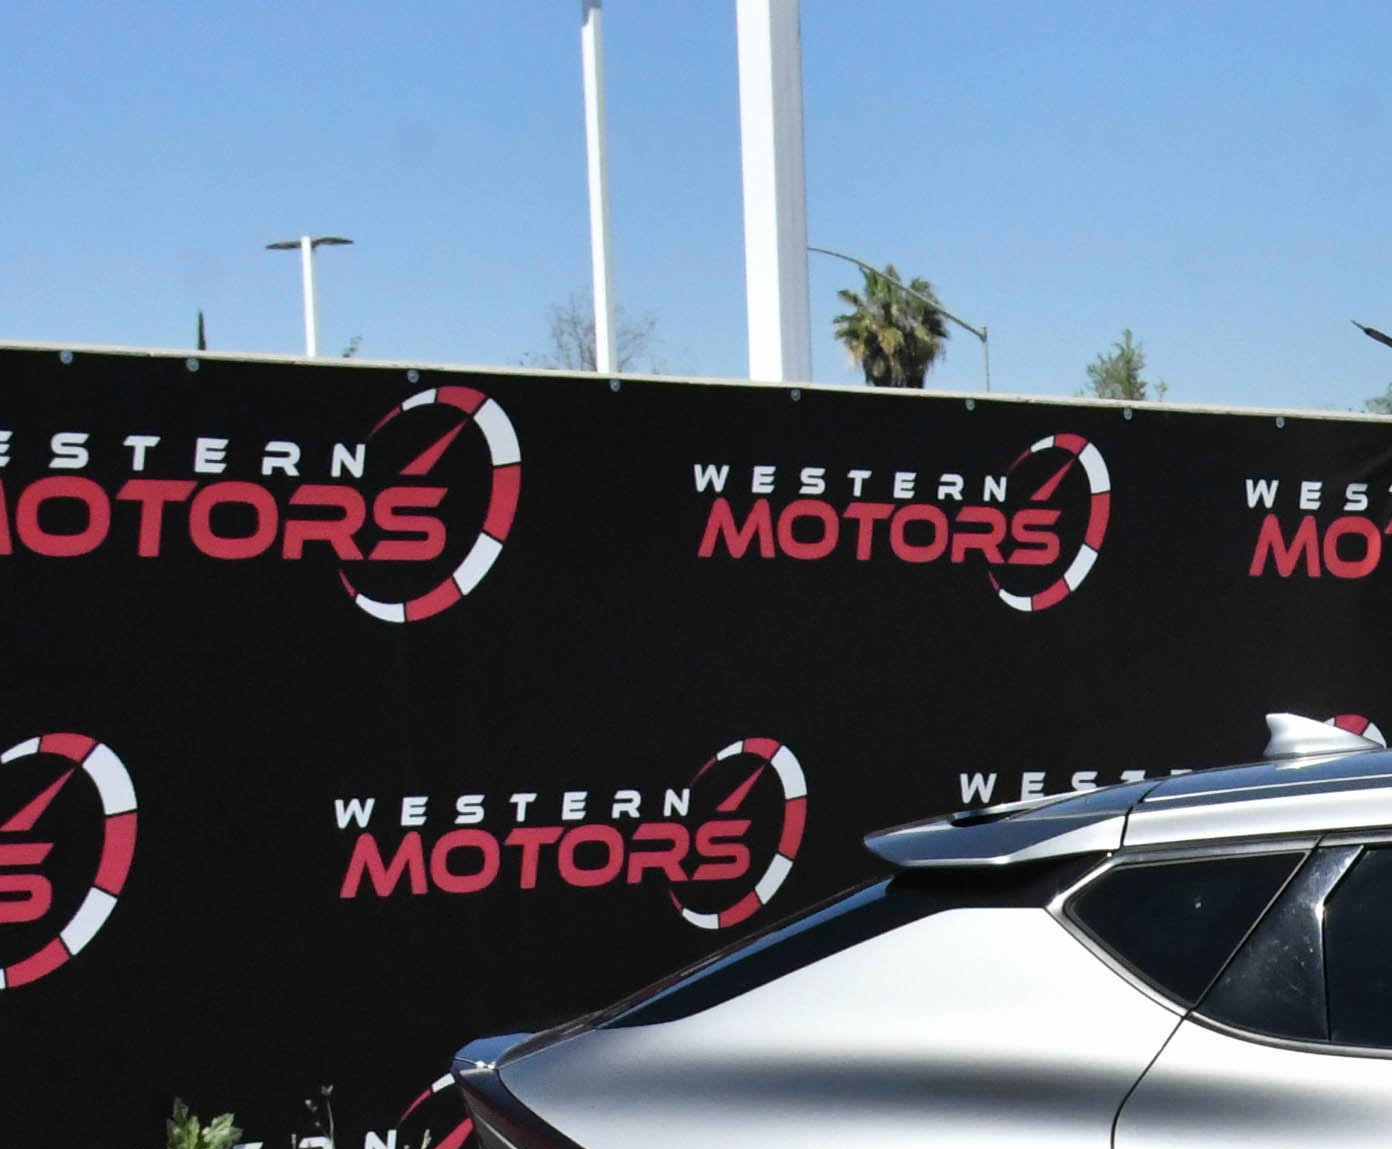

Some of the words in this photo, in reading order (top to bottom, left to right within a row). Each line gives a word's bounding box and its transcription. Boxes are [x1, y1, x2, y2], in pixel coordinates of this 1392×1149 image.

[694, 464, 1007, 503] WESTERN
[0, 475, 448, 561] OTORS
[698, 498, 1061, 565] MOTORS
[334, 788, 690, 829] WESTERN
[340, 820, 752, 899] MOTORS
